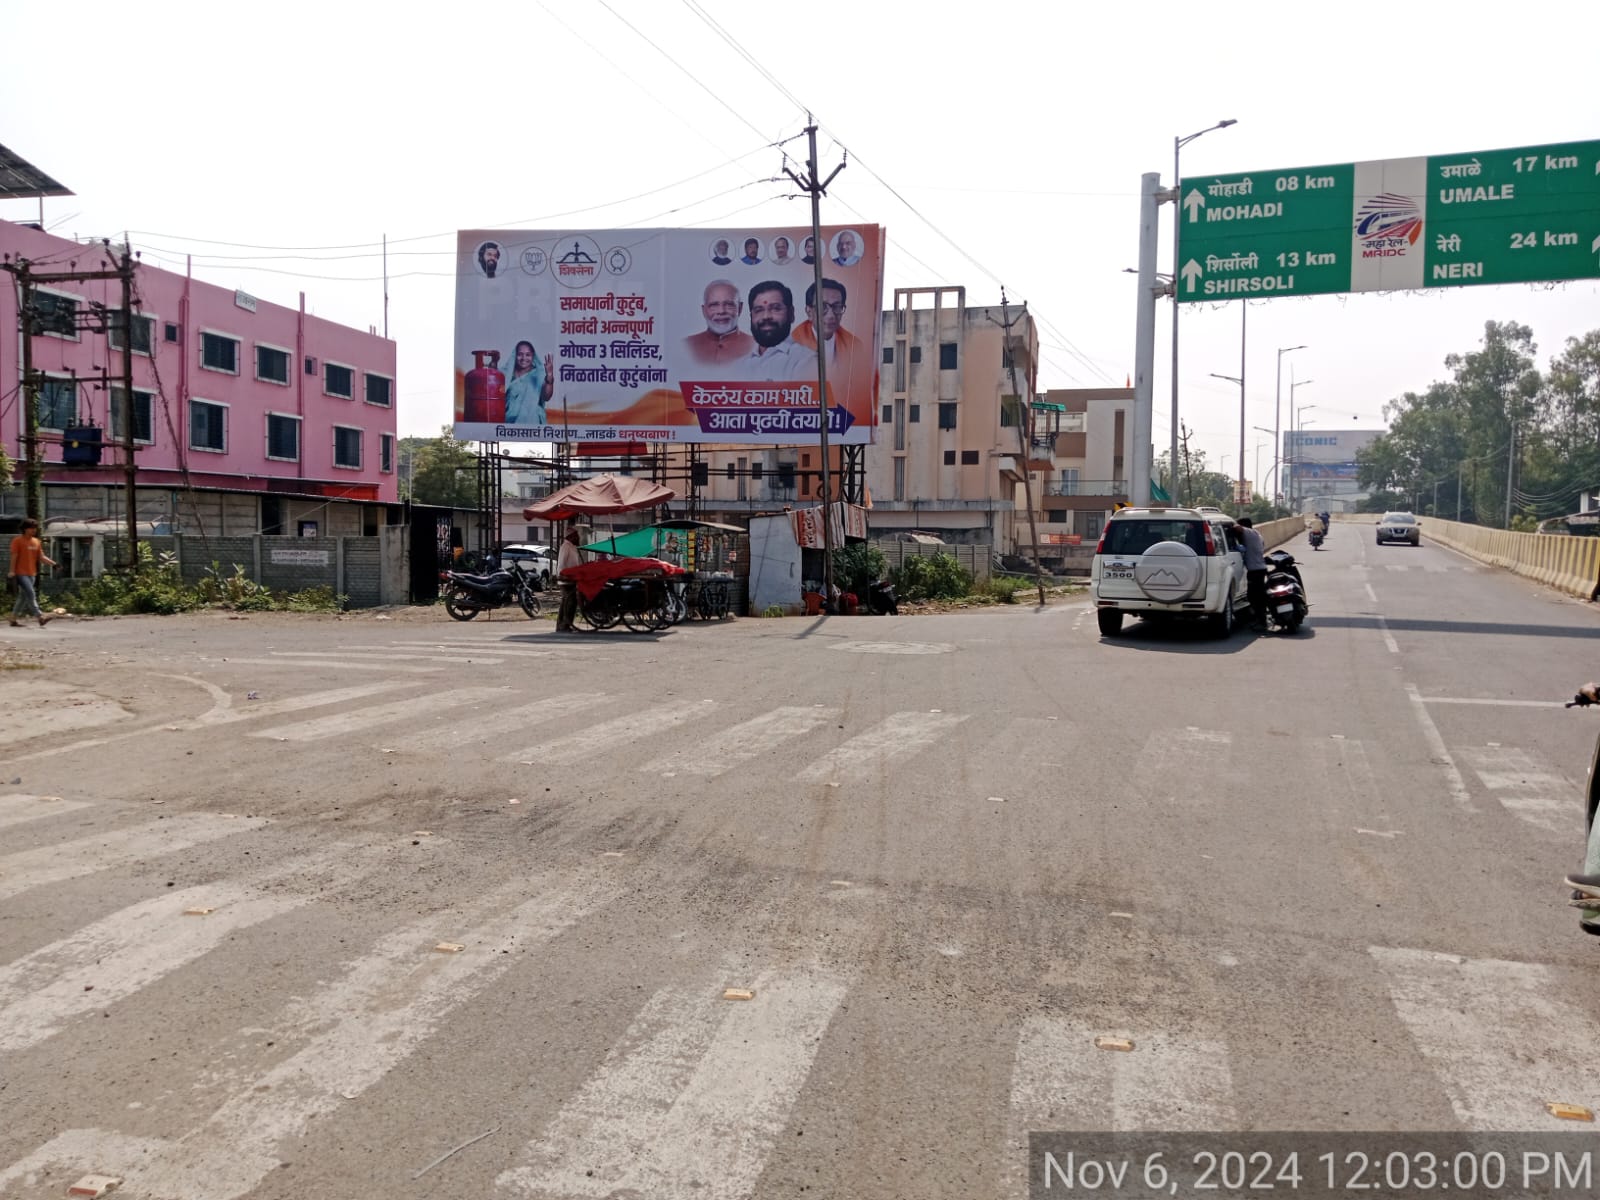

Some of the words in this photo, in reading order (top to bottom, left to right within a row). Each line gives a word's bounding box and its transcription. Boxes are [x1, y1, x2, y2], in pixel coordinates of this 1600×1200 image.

[1439, 158, 1482, 178] उमाळे
[1512, 156, 1538, 173] 17
[1545, 154, 1578, 170] km
[1208, 177, 1253, 198] मोहाडी
[1275, 175, 1299, 192] 08
[1305, 175, 1335, 190] km
[1440, 184, 1515, 204] UMALE
[1206, 202, 1283, 222] MOHADI
[1435, 233, 1461, 252] नेरी
[1510, 232, 1537, 249] 24
[1543, 231, 1578, 247] km
[1276, 252, 1299, 268] 13
[1305, 251, 1336, 266] km
[1362, 248, 1406, 258] MRIDC
[559, 264, 594, 276] शिवसेना
[1433, 262, 1483, 279] NERI
[1204, 275, 1294, 295] SHIRSOLI
[560, 292, 614, 310] समाधानी
[616, 293, 648, 316] कुटुंब,
[560, 316, 598, 334] आनंदी
[600, 316, 655, 339] अन्नपूर्णा
[559, 340, 597, 359] मोफत
[610, 340, 663, 361] सिलिंडर,
[559, 364, 617, 382] मिळताहेत
[619, 365, 668, 388] कुटुंबांना
[691, 385, 742, 405] केलंय
[743, 389, 780, 405] काम
[496, 425, 541, 438] विकासाचं
[708, 412, 747, 429] आता
[749, 409, 791, 435] पुढची
[792, 409, 840, 429] तयाी!
